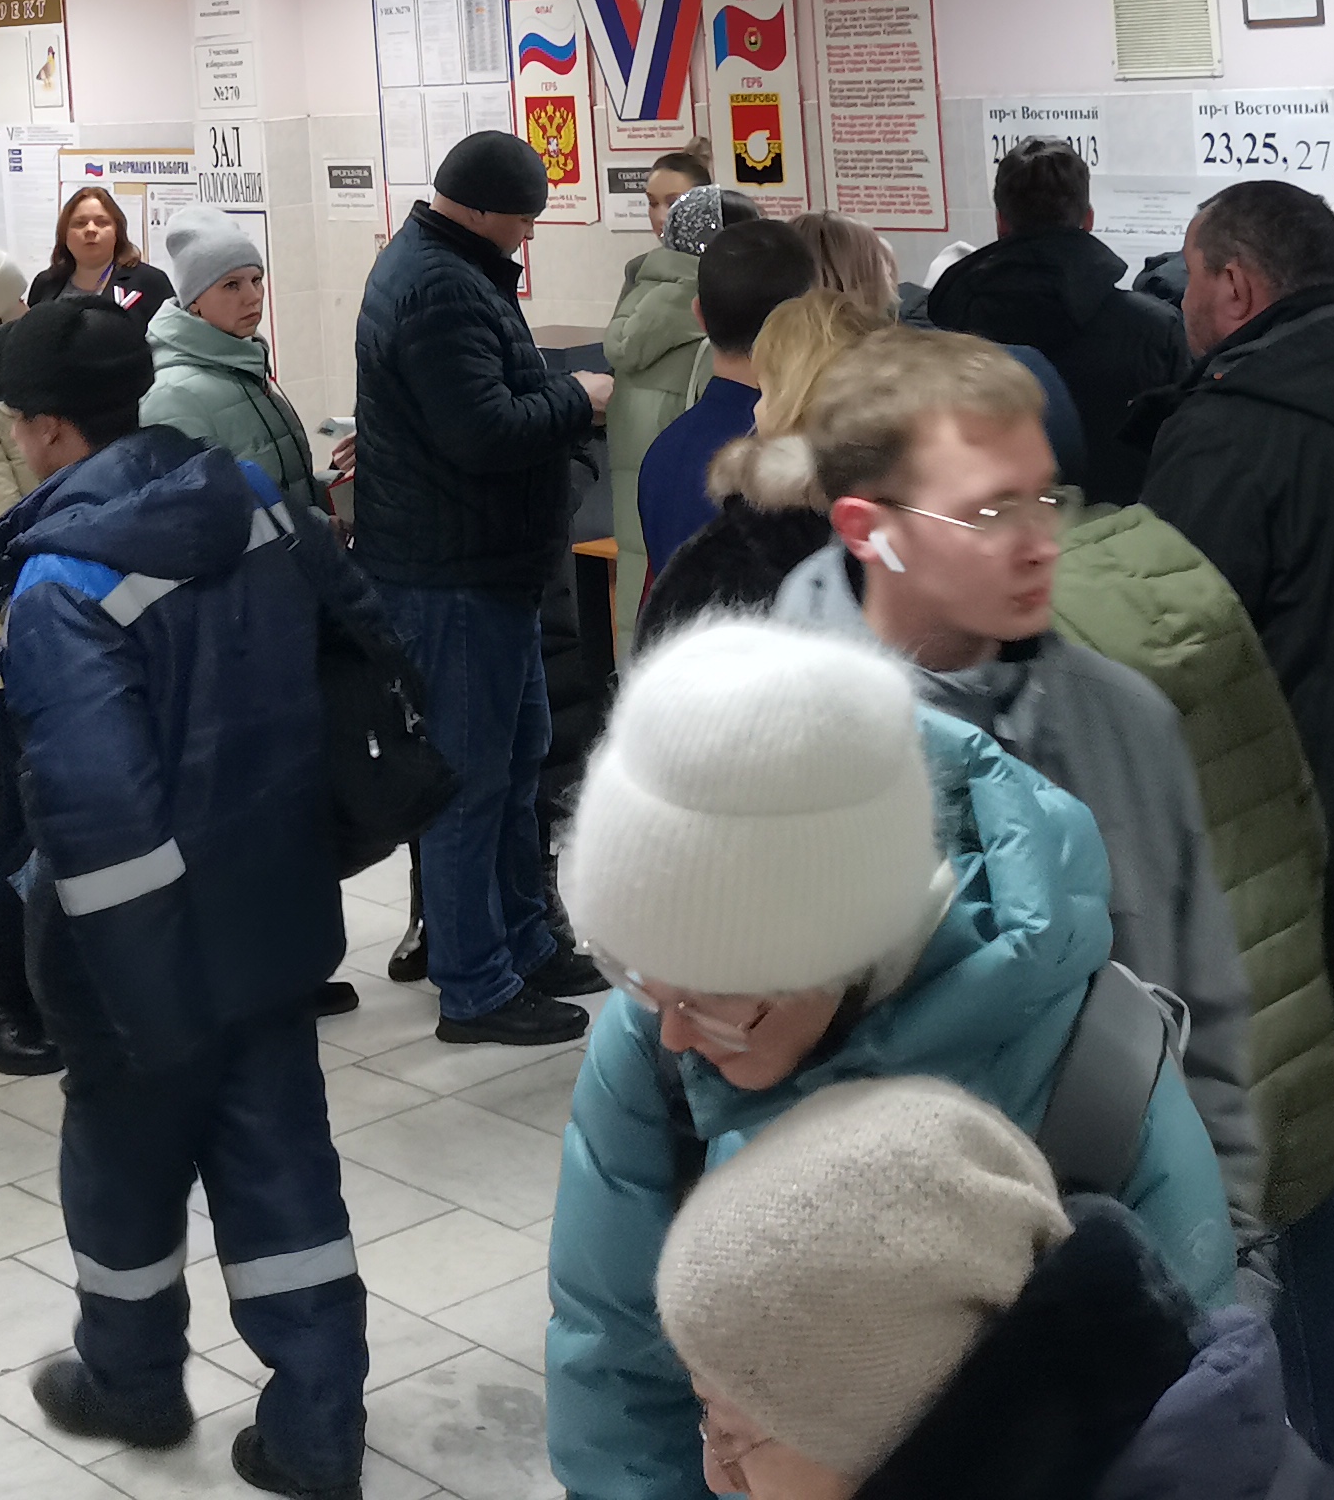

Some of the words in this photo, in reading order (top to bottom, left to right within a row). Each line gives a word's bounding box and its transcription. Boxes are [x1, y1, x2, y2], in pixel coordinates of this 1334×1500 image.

[535, 4, 554, 15] ФЛАГ
[540, 81, 558, 92] ГЕРБ
[741, 77, 763, 89] ГЕРБ
[212, 85, 241, 102] №270
[730, 93, 778, 104] КЕМЕРОВО
[989, 106, 1017, 121] пр-т
[1021, 105, 1099, 120] Восточный
[1199, 102, 1229, 116] пр-т
[1235, 100, 1330, 116] Восточный
[208, 126, 242, 168] ЗАЛ
[109, 160, 152, 174] ИНФОРМАЦИЯ
[158, 161, 196, 174] ВЫБОРА
[198, 172, 264, 203] ГОЛОСОВАНИЯ
